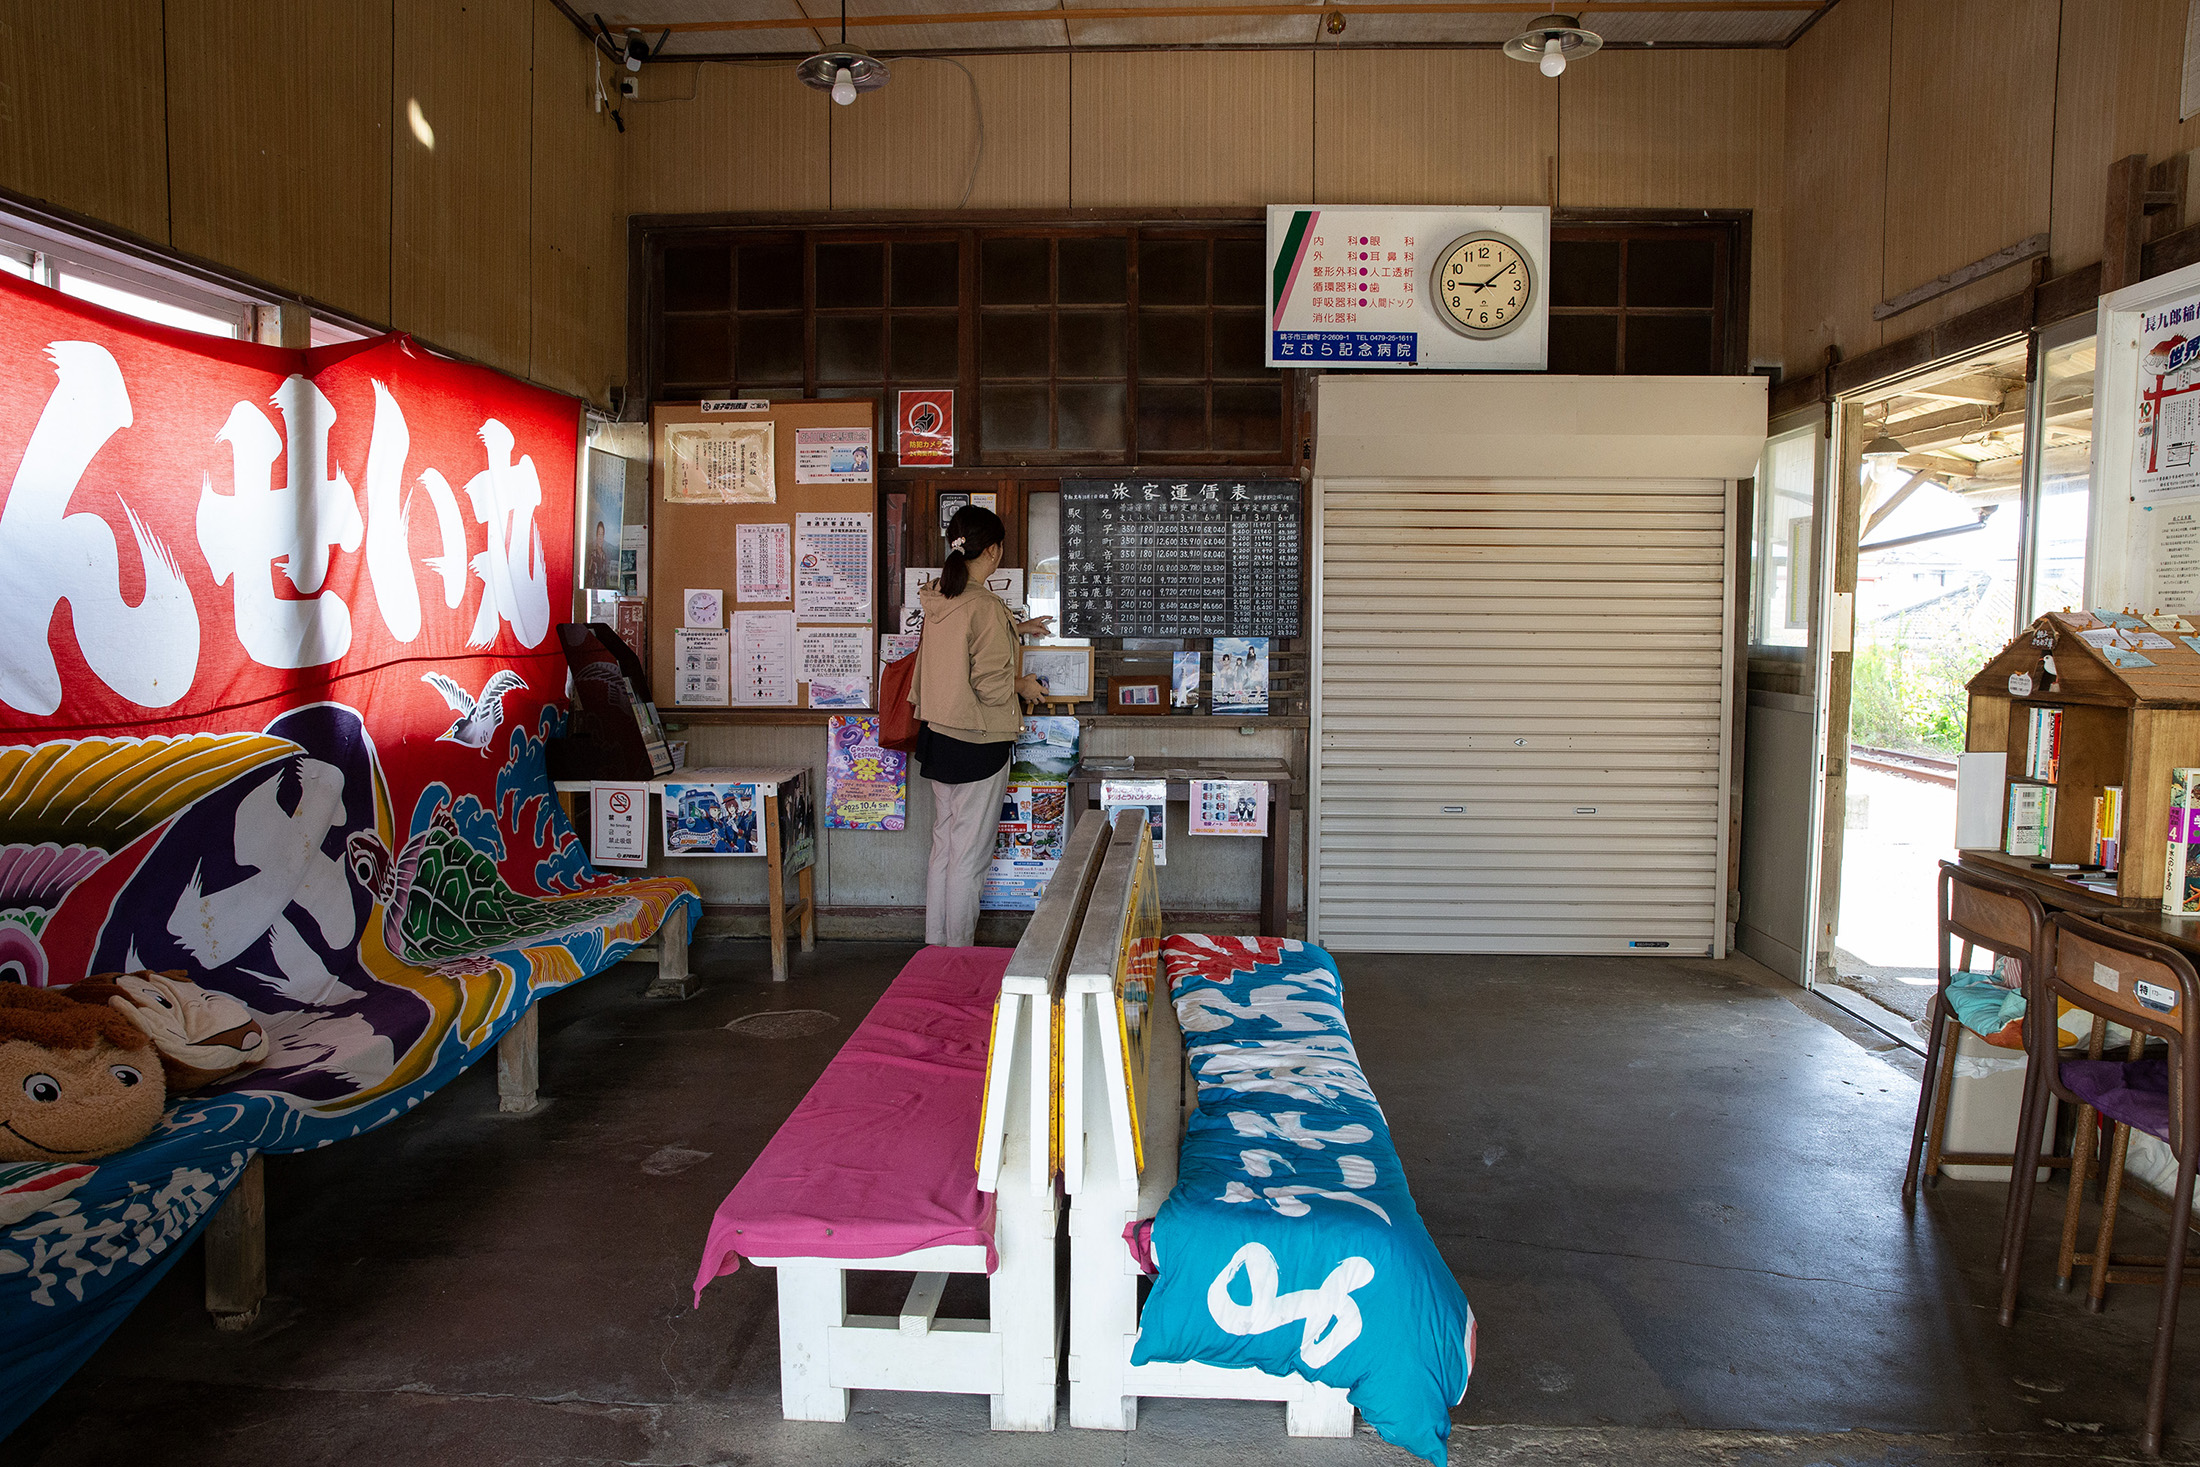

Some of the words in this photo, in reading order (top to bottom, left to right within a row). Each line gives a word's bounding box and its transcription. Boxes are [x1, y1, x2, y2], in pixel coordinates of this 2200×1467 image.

[1464, 251, 1473, 262] 11
[1478, 247, 1490, 259] 12
[1313, 266, 1358, 277] 整形外科
[1369, 267, 1414, 278] 人工透析
[1452, 263, 1463, 275] 10
[1508, 262, 1517, 274] 2
[1312, 282, 1358, 293] 循環器科
[1446, 279, 1456, 291] 9
[1513, 279, 1522, 291] 3
[1312, 297, 1357, 308] 呼吸器科
[1369, 297, 1414, 309] 人間ドック
[1452, 295, 1461, 308] 8
[1507, 296, 1516, 307] 4
[1312, 312, 1357, 323] 消化器科
[1465, 308, 1474, 320] 7
[1479, 311, 1489, 323] 6
[1495, 308, 1504, 319] 5
[1370, 334, 1414, 342] 0479-25-1611
[1281, 342, 1412, 358] たむら記念病院
[909, 441, 943, 449] 防犯カメラ
[1112, 483, 1251, 501] 旅客運賃表
[1121, 525, 1136, 533] 350
[1140, 525, 1153, 533] 180
[1120, 538, 1136, 546] 350
[1139, 538, 1153, 546] 180
[1120, 550, 1135, 558] 350
[1139, 550, 1152, 558] 180
[1120, 563, 1134, 571] 300
[1139, 563, 1152, 571] 150
[1067, 575, 1113, 585] 笠上黒生
[1120, 576, 1135, 584] 270
[1139, 576, 1152, 584] 140
[1120, 588, 1135, 597] 270
[1139, 588, 1152, 597] 140
[1120, 601, 1135, 609] 240
[1139, 601, 1152, 609] 120
[1120, 614, 1134, 622] 210
[1139, 614, 1152, 622] 110
[1120, 626, 1133, 634] 180
[1142, 626, 1152, 634] 90
[860, 802, 877, 810] 10.4
[2169, 826, 2178, 840] 4
